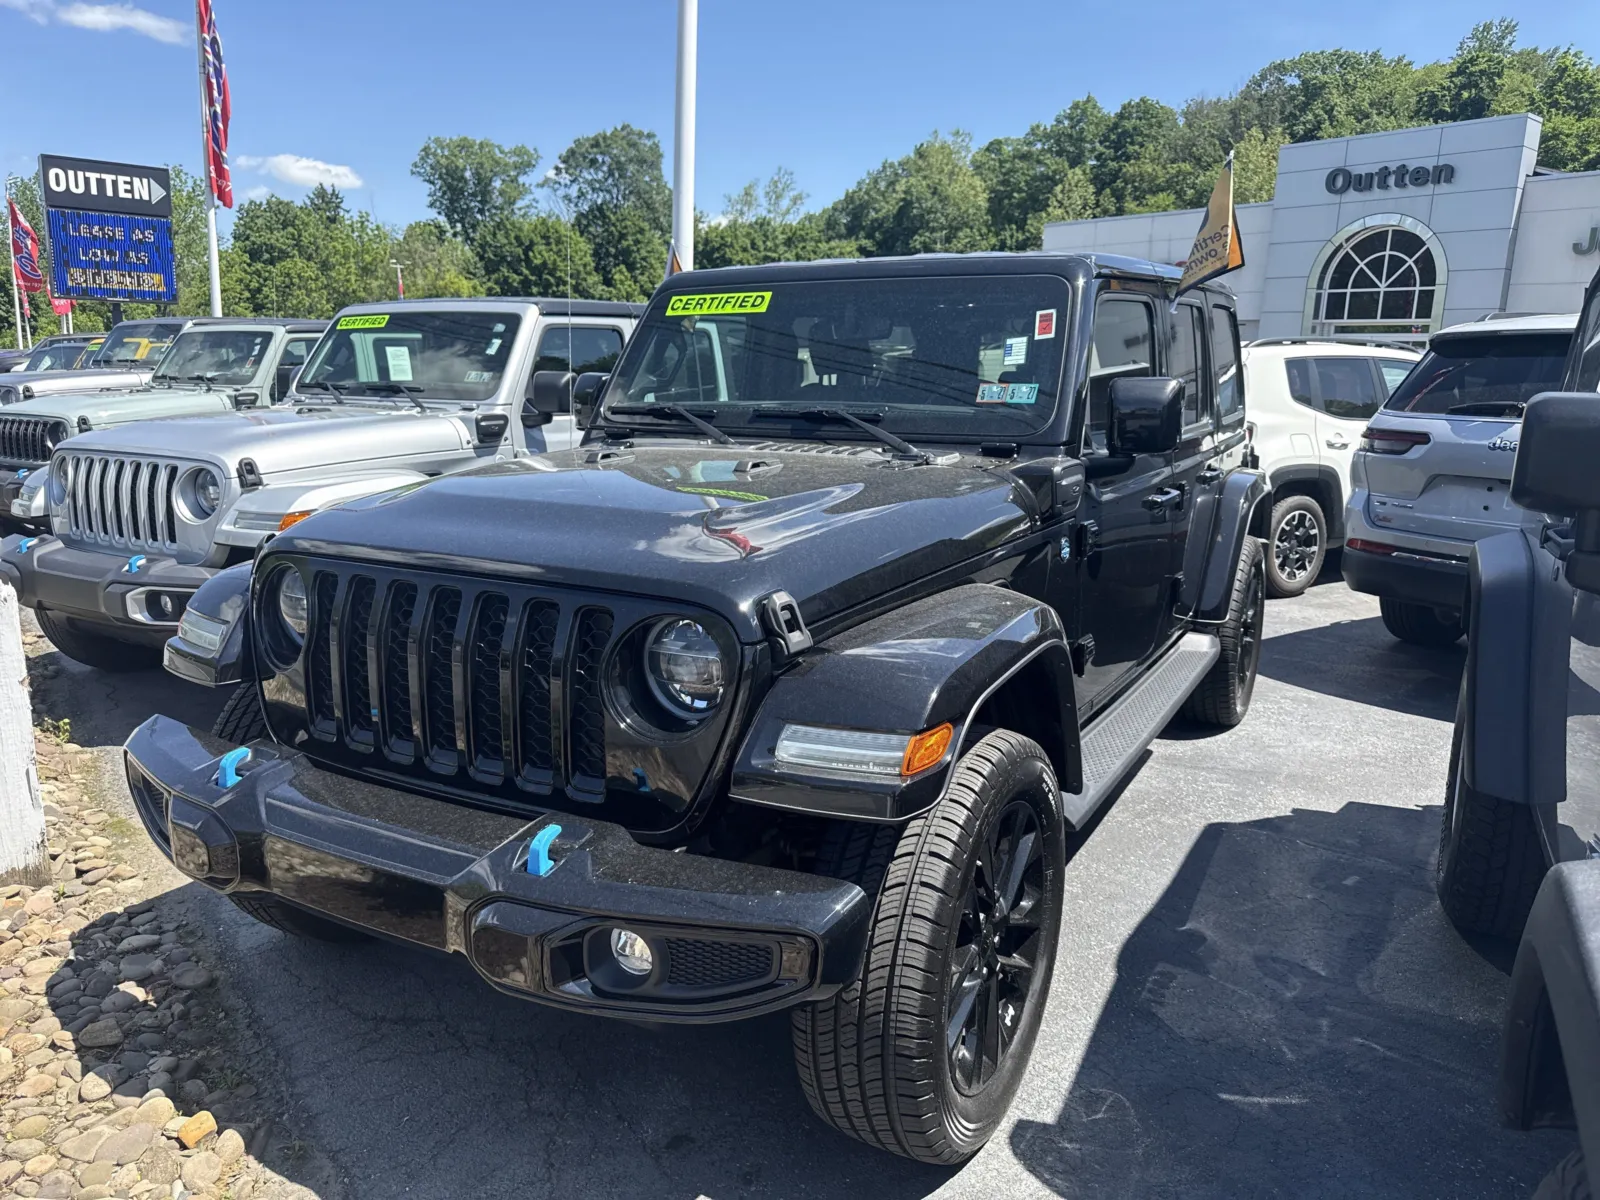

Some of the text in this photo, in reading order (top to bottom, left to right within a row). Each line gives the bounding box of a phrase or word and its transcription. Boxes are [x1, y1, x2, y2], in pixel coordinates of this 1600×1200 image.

[48, 168, 150, 200] OUTTEN
[1325, 164, 1454, 195] Outten
[69, 223, 155, 242] LEASE AS
[670, 294, 766, 311] CERTIFIED
[340, 317, 386, 327] CERTIFIED
[1488, 437, 1519, 452] Jee
